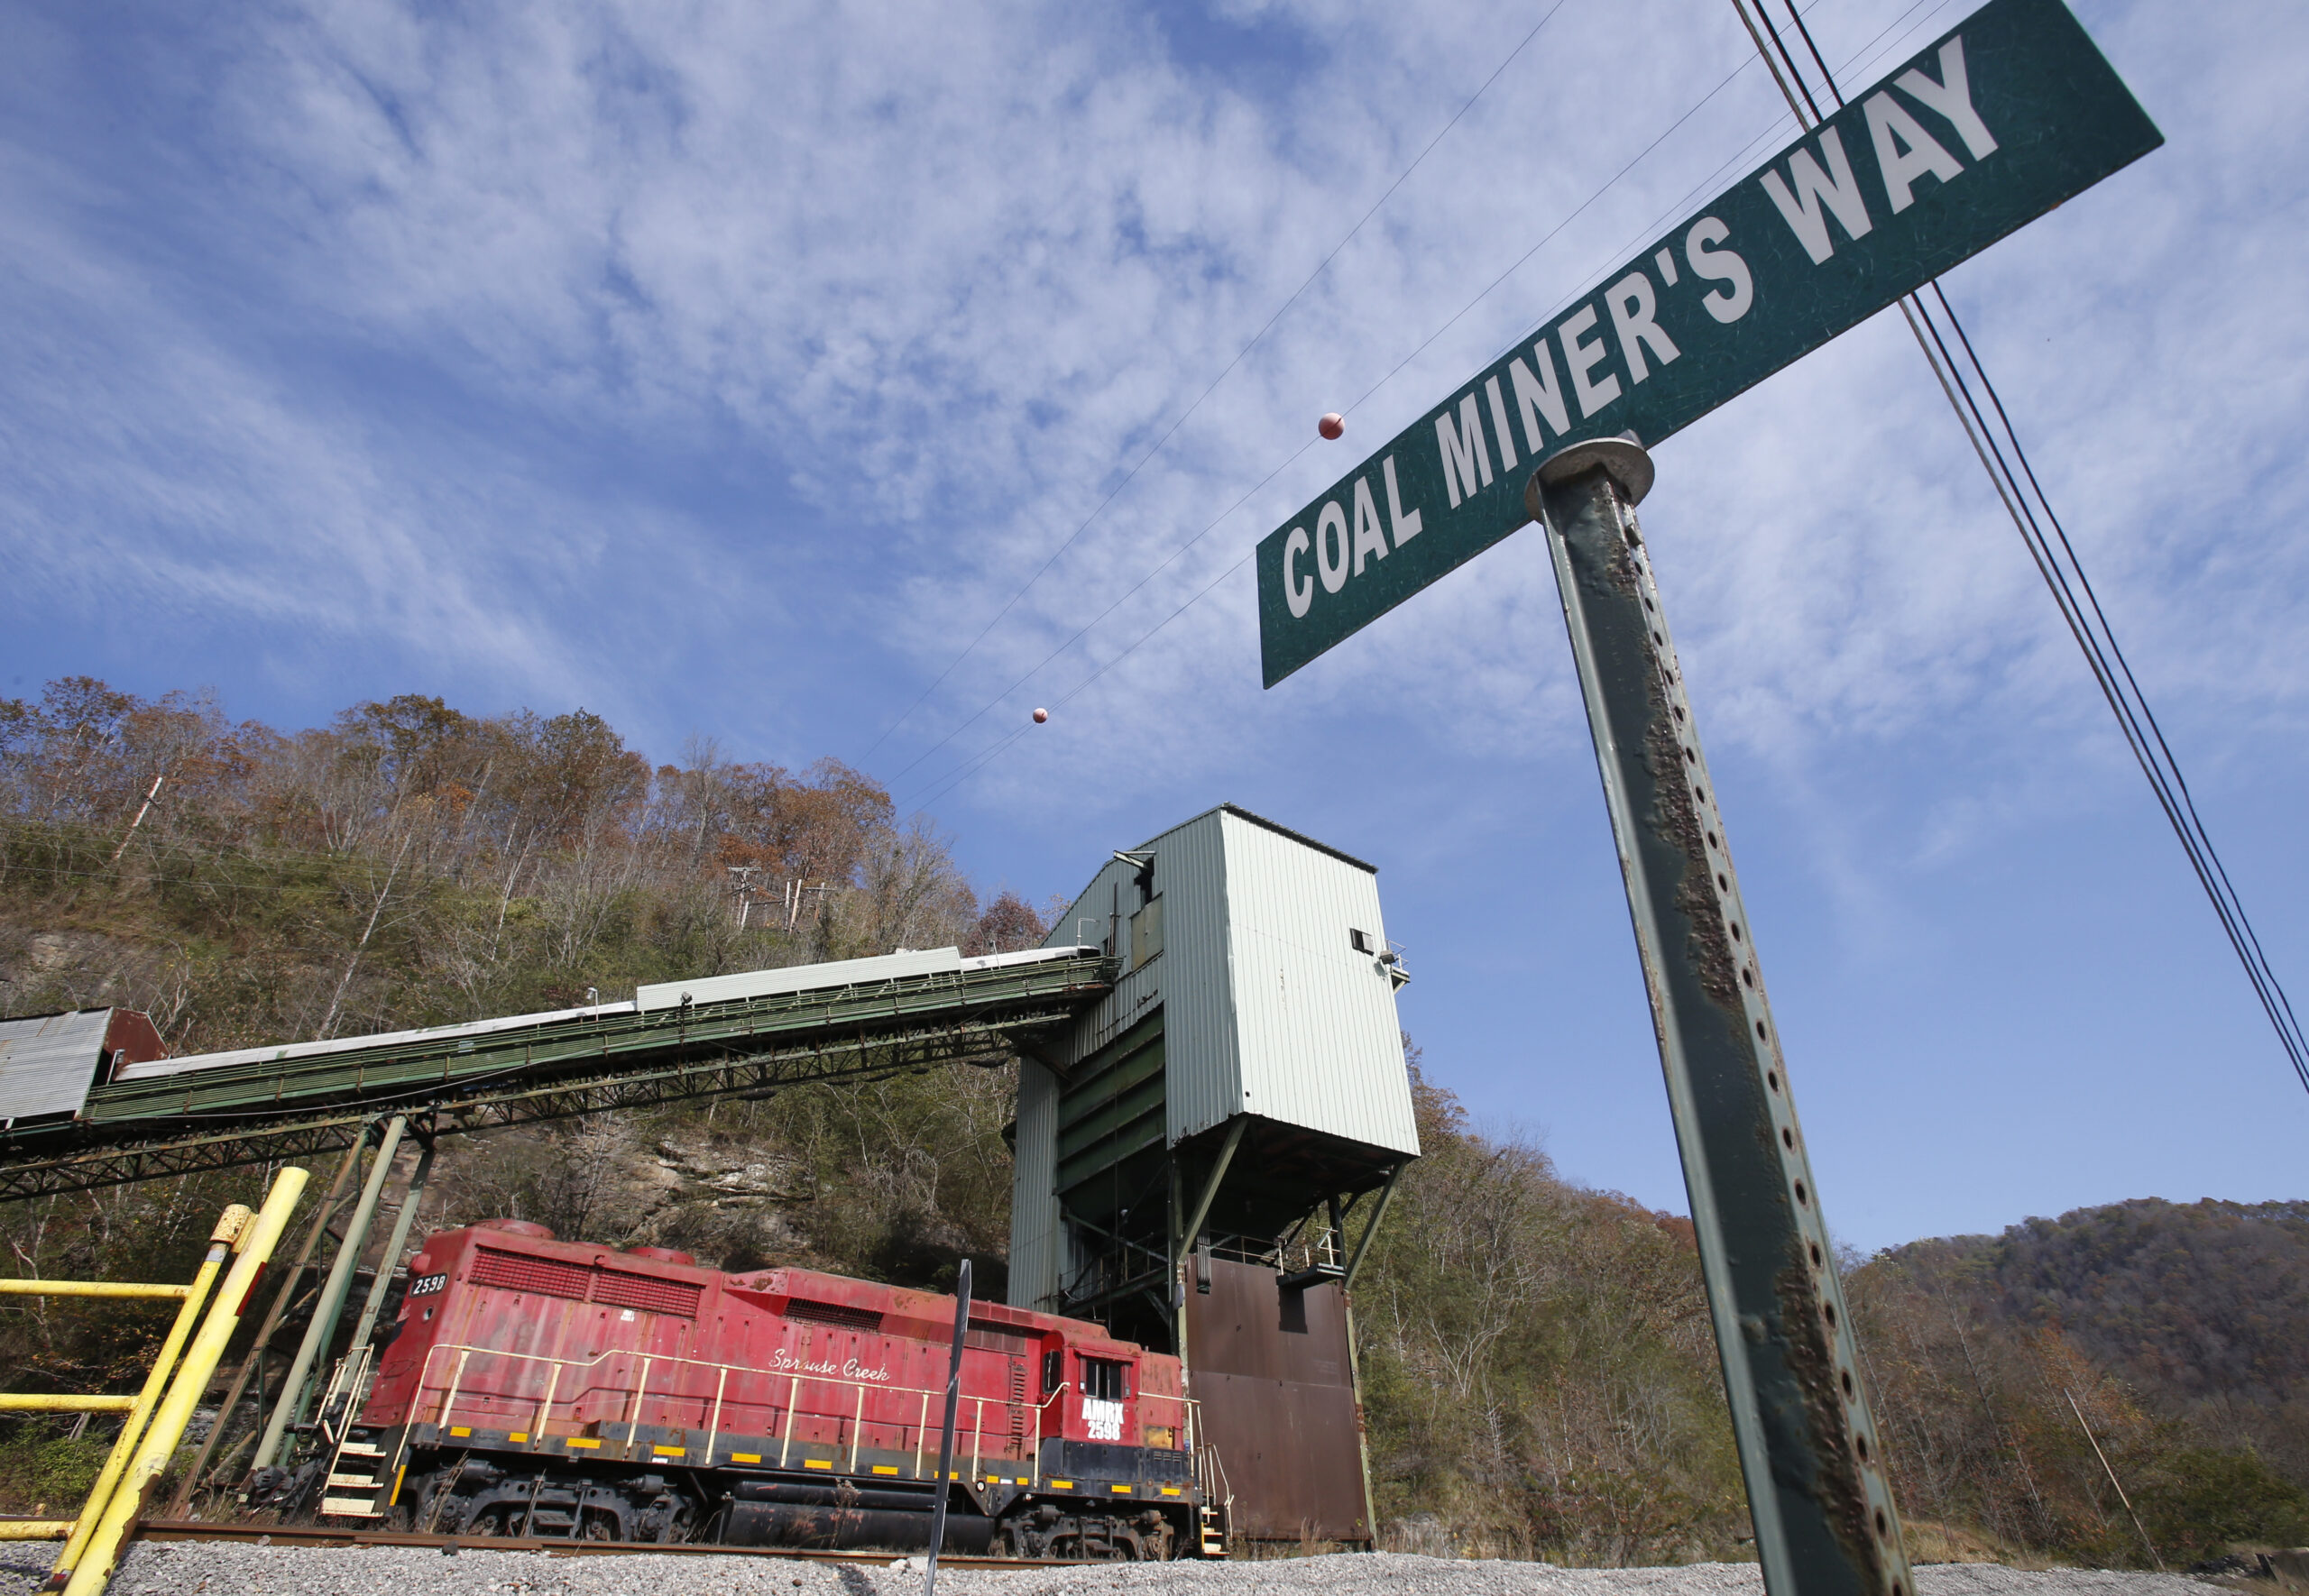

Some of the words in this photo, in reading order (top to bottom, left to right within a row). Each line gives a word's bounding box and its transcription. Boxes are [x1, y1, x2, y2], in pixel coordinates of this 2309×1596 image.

[1283, 454, 1422, 619] COAL
[1434, 216, 1754, 510] MINER'S
[1758, 34, 1999, 266] WAY
[412, 1275, 446, 1294] 2598
[768, 1348, 839, 1375] Sprouse
[842, 1358, 890, 1381] Creek
[1081, 1398, 1124, 1425] AMRX
[1087, 1420, 1121, 1440] 2598
